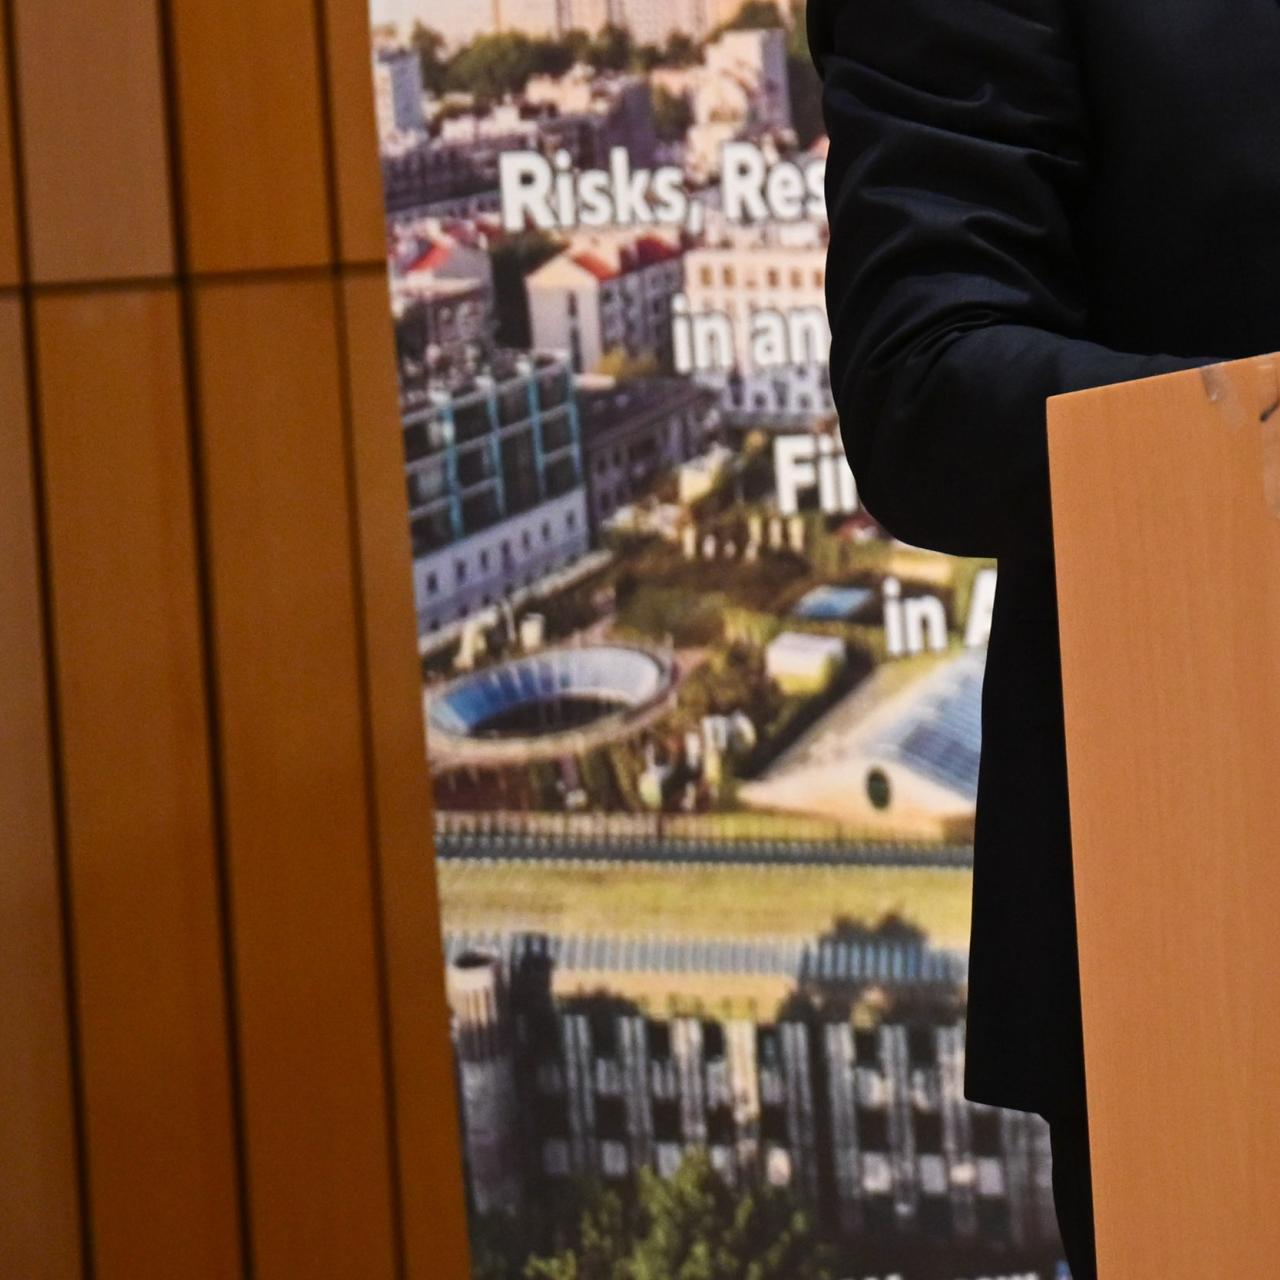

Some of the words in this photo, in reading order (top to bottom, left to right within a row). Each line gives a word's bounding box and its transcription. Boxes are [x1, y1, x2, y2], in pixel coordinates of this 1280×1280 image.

[499, 146, 704, 233] Risks,
[671, 292, 734, 374] in
[882, 575, 949, 657] in
